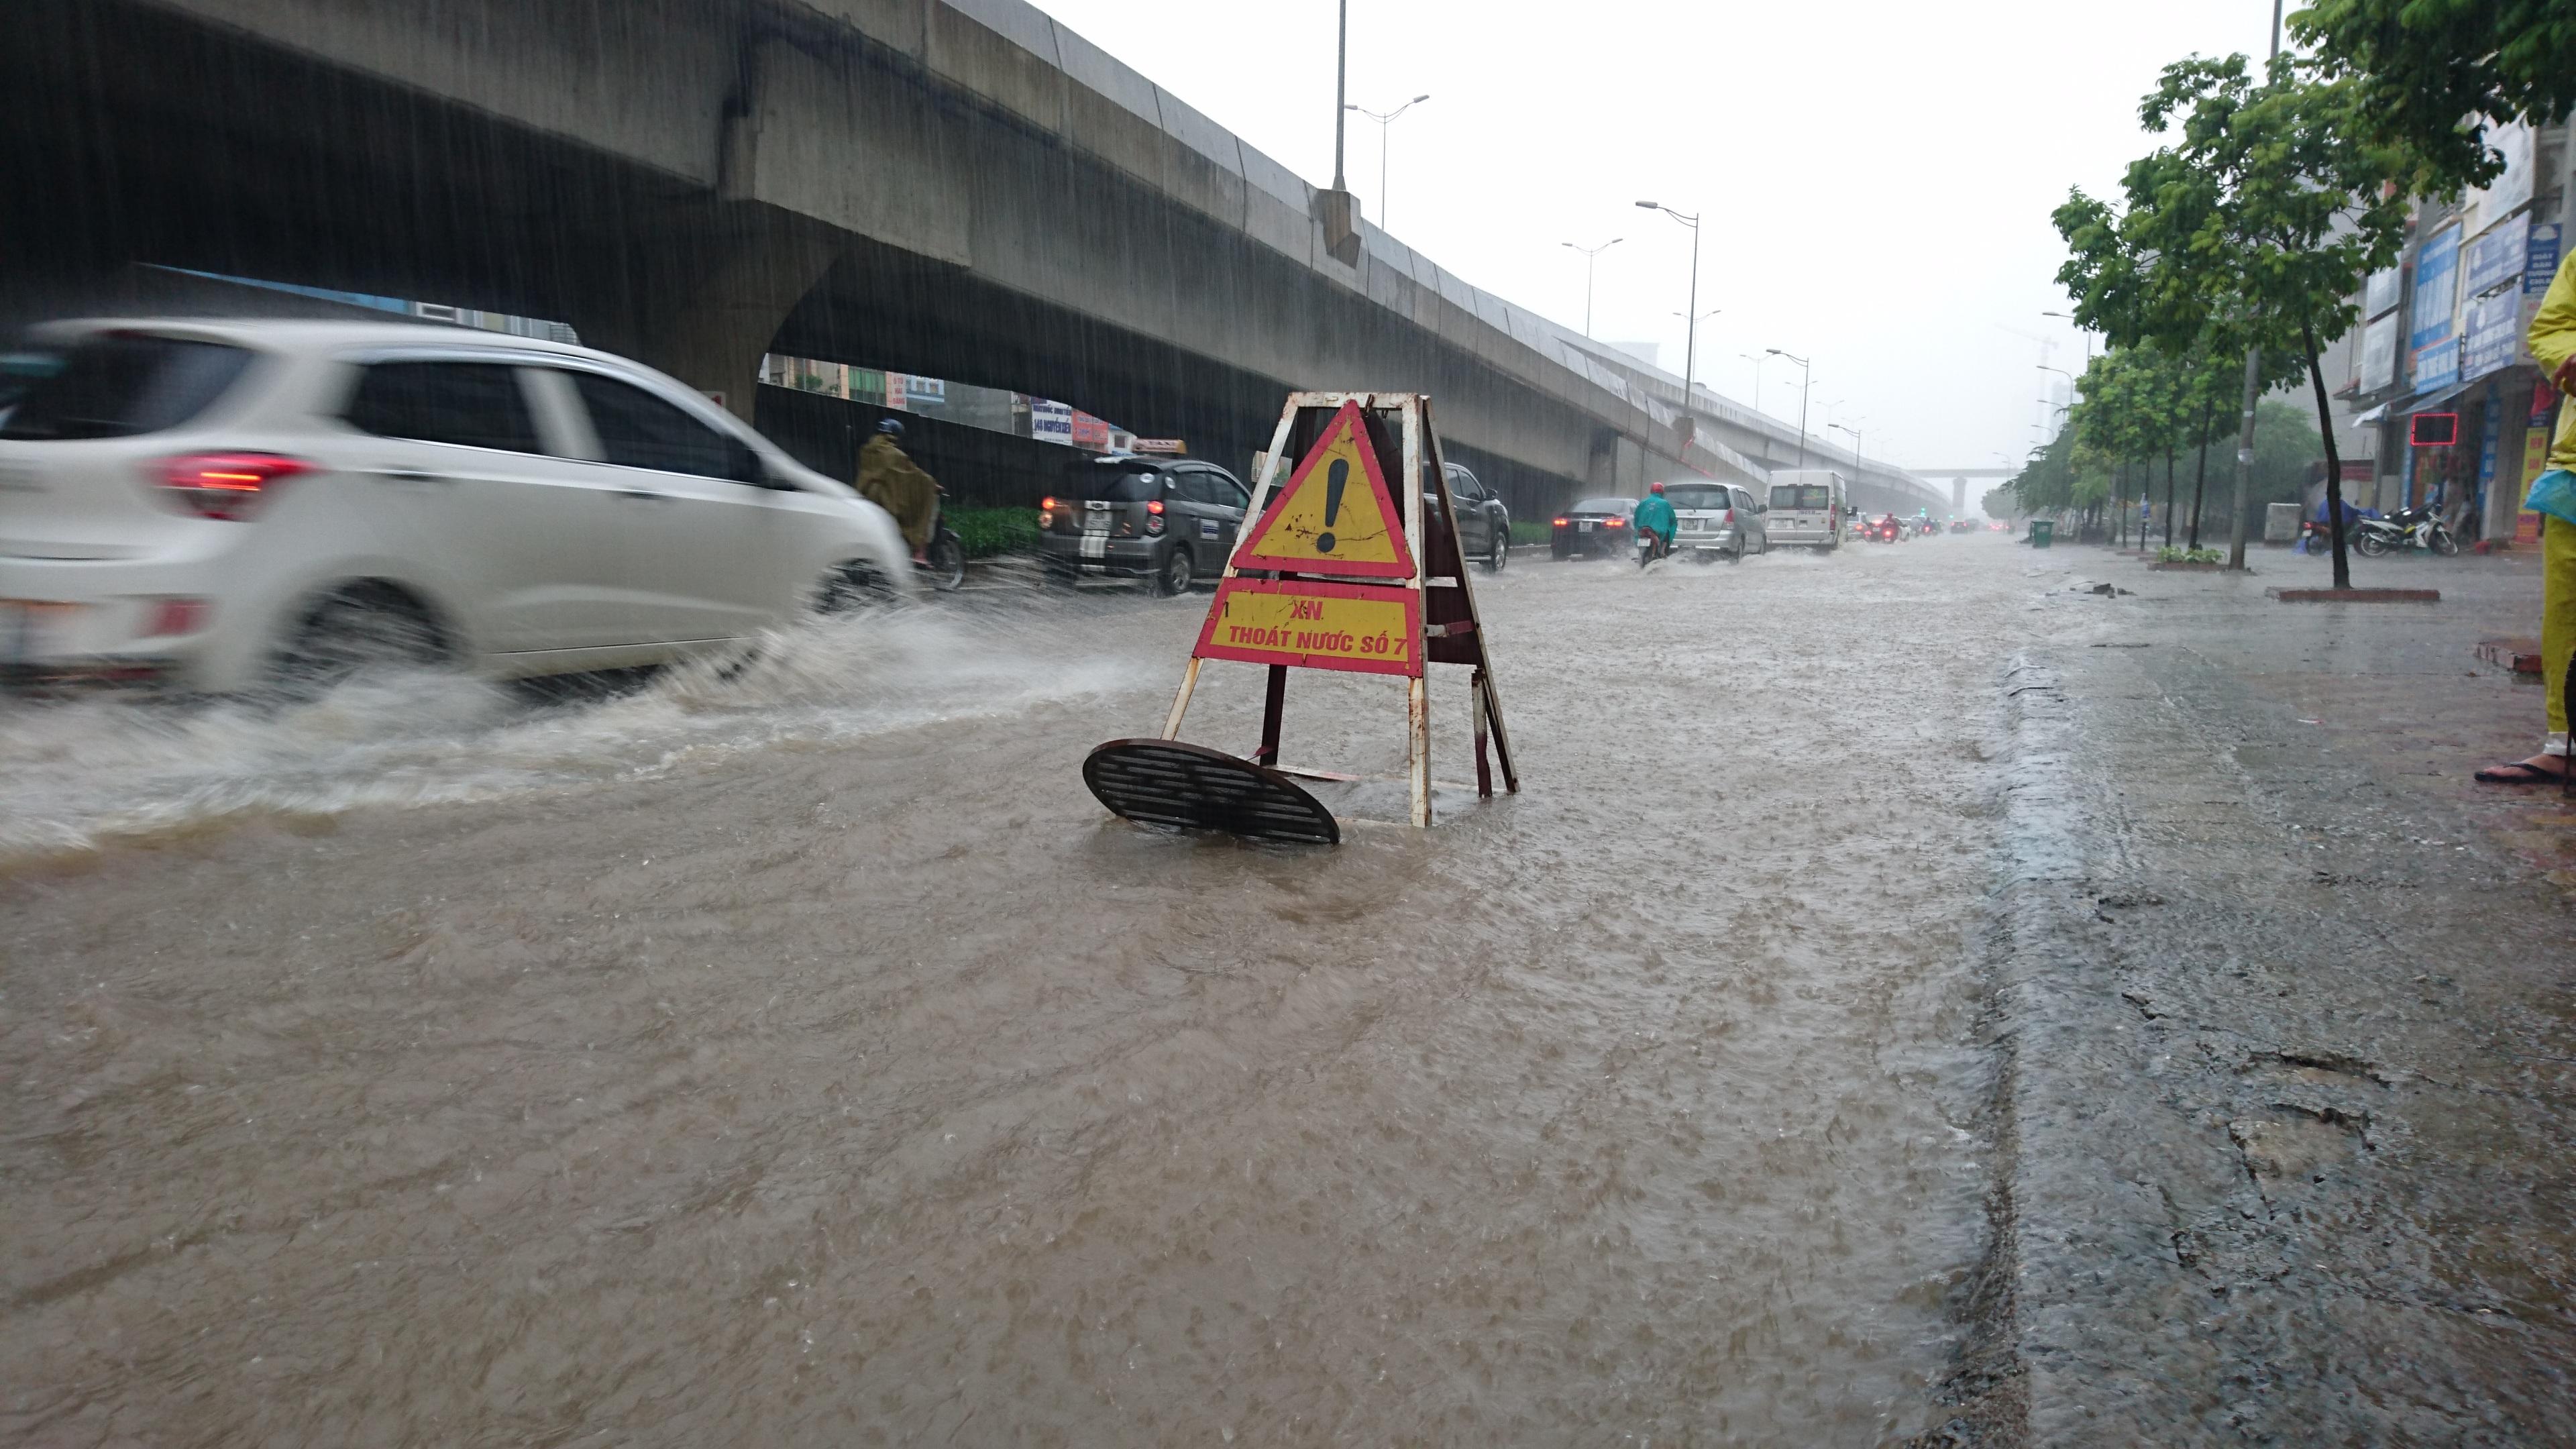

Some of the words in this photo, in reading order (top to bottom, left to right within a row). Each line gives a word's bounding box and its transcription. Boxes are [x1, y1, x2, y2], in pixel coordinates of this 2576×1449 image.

[1290, 600, 1324, 621] XN
[1230, 625, 1292, 647] THOÁT
[1296, 629, 1354, 652] NƯỚC
[1360, 630, 1389, 654] SỐ
[1394, 638, 1407, 655] 7
